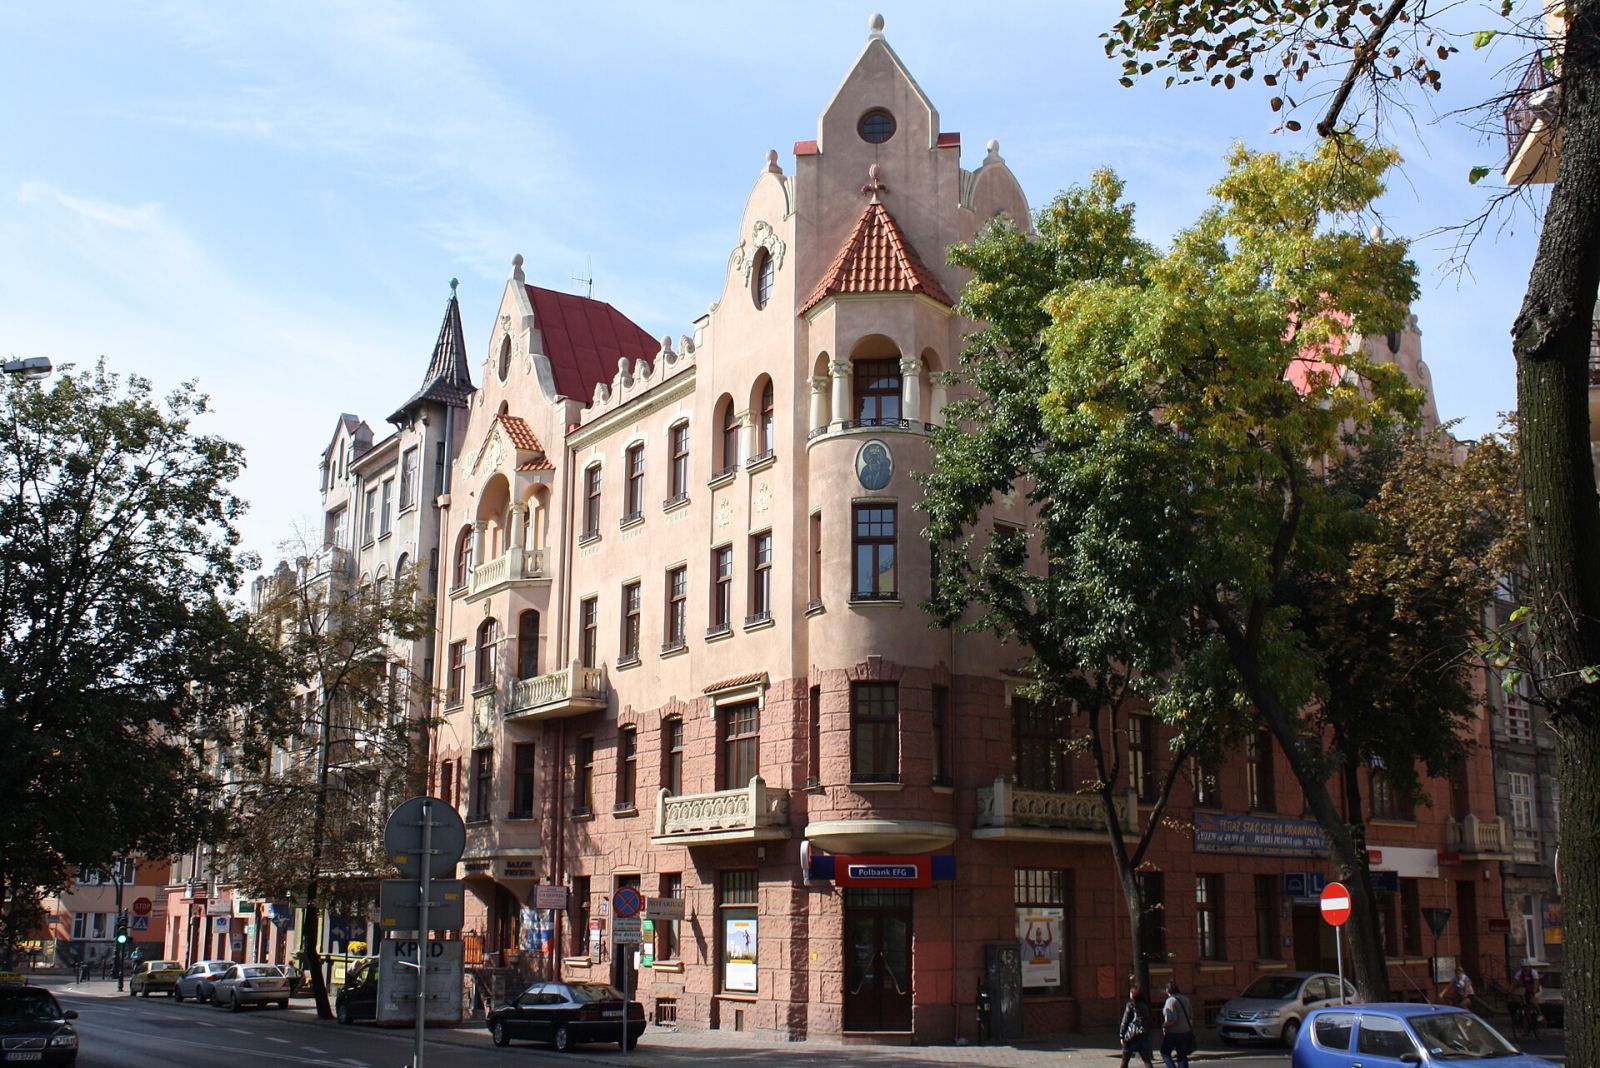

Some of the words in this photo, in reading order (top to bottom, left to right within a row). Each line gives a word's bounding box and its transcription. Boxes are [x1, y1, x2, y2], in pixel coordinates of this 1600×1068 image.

[858, 868, 891, 876] Polbank
[892, 868, 907, 876] EFG
[134, 903, 151, 912] STOP
